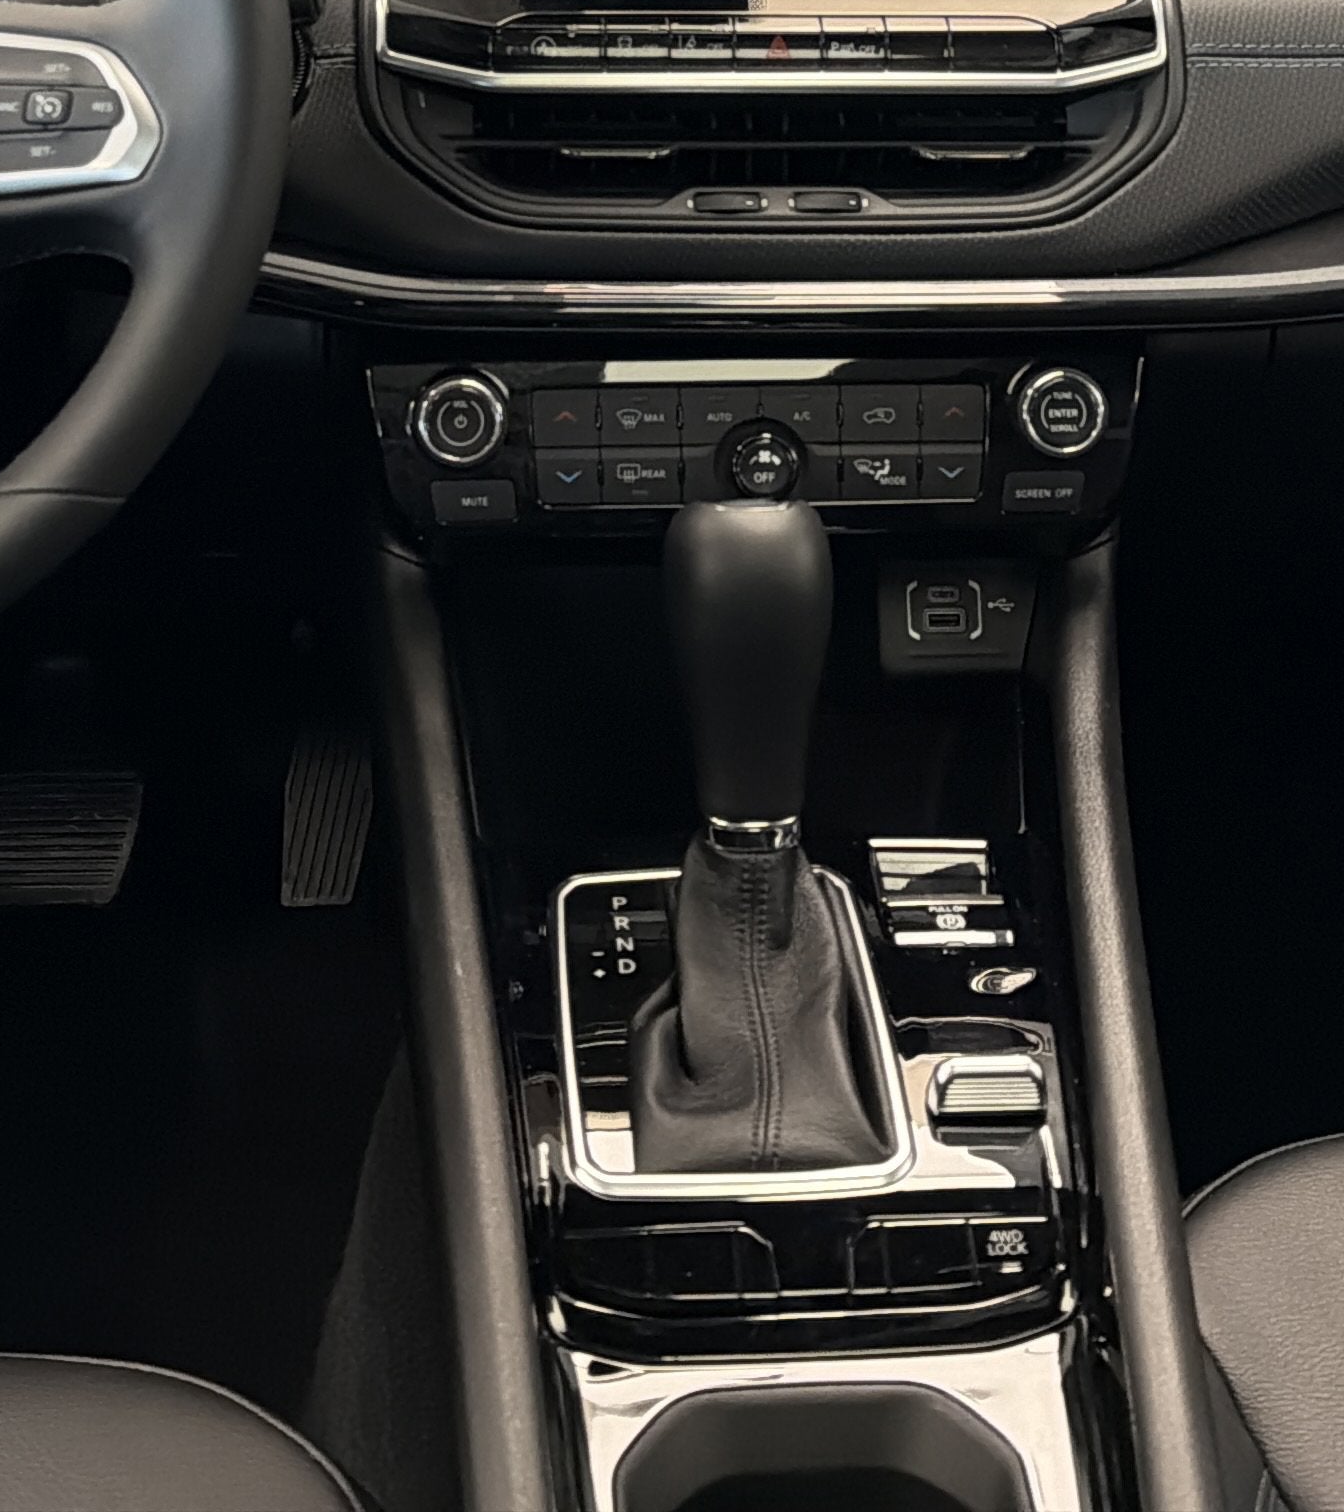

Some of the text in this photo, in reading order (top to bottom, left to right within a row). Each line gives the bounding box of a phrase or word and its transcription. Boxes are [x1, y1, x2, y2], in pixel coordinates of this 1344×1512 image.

[707, 412, 733, 422] AUTO
[793, 410, 811, 421] A/C
[1048, 409, 1078, 418] ENTER
[641, 469, 666, 480] REAR
[753, 471, 776, 483] OFF
[879, 475, 906, 486] MODE
[1015, 488, 1073, 498] SCREEN OFF
[461, 496, 488, 507] MUTE
[612, 896, 628, 910] P
[614, 916, 630, 931] R
[616, 936, 634, 952] N
[618, 958, 636, 975] D
[989, 1230, 1024, 1242] 4WD
[986, 1242, 1029, 1256] LOCK
